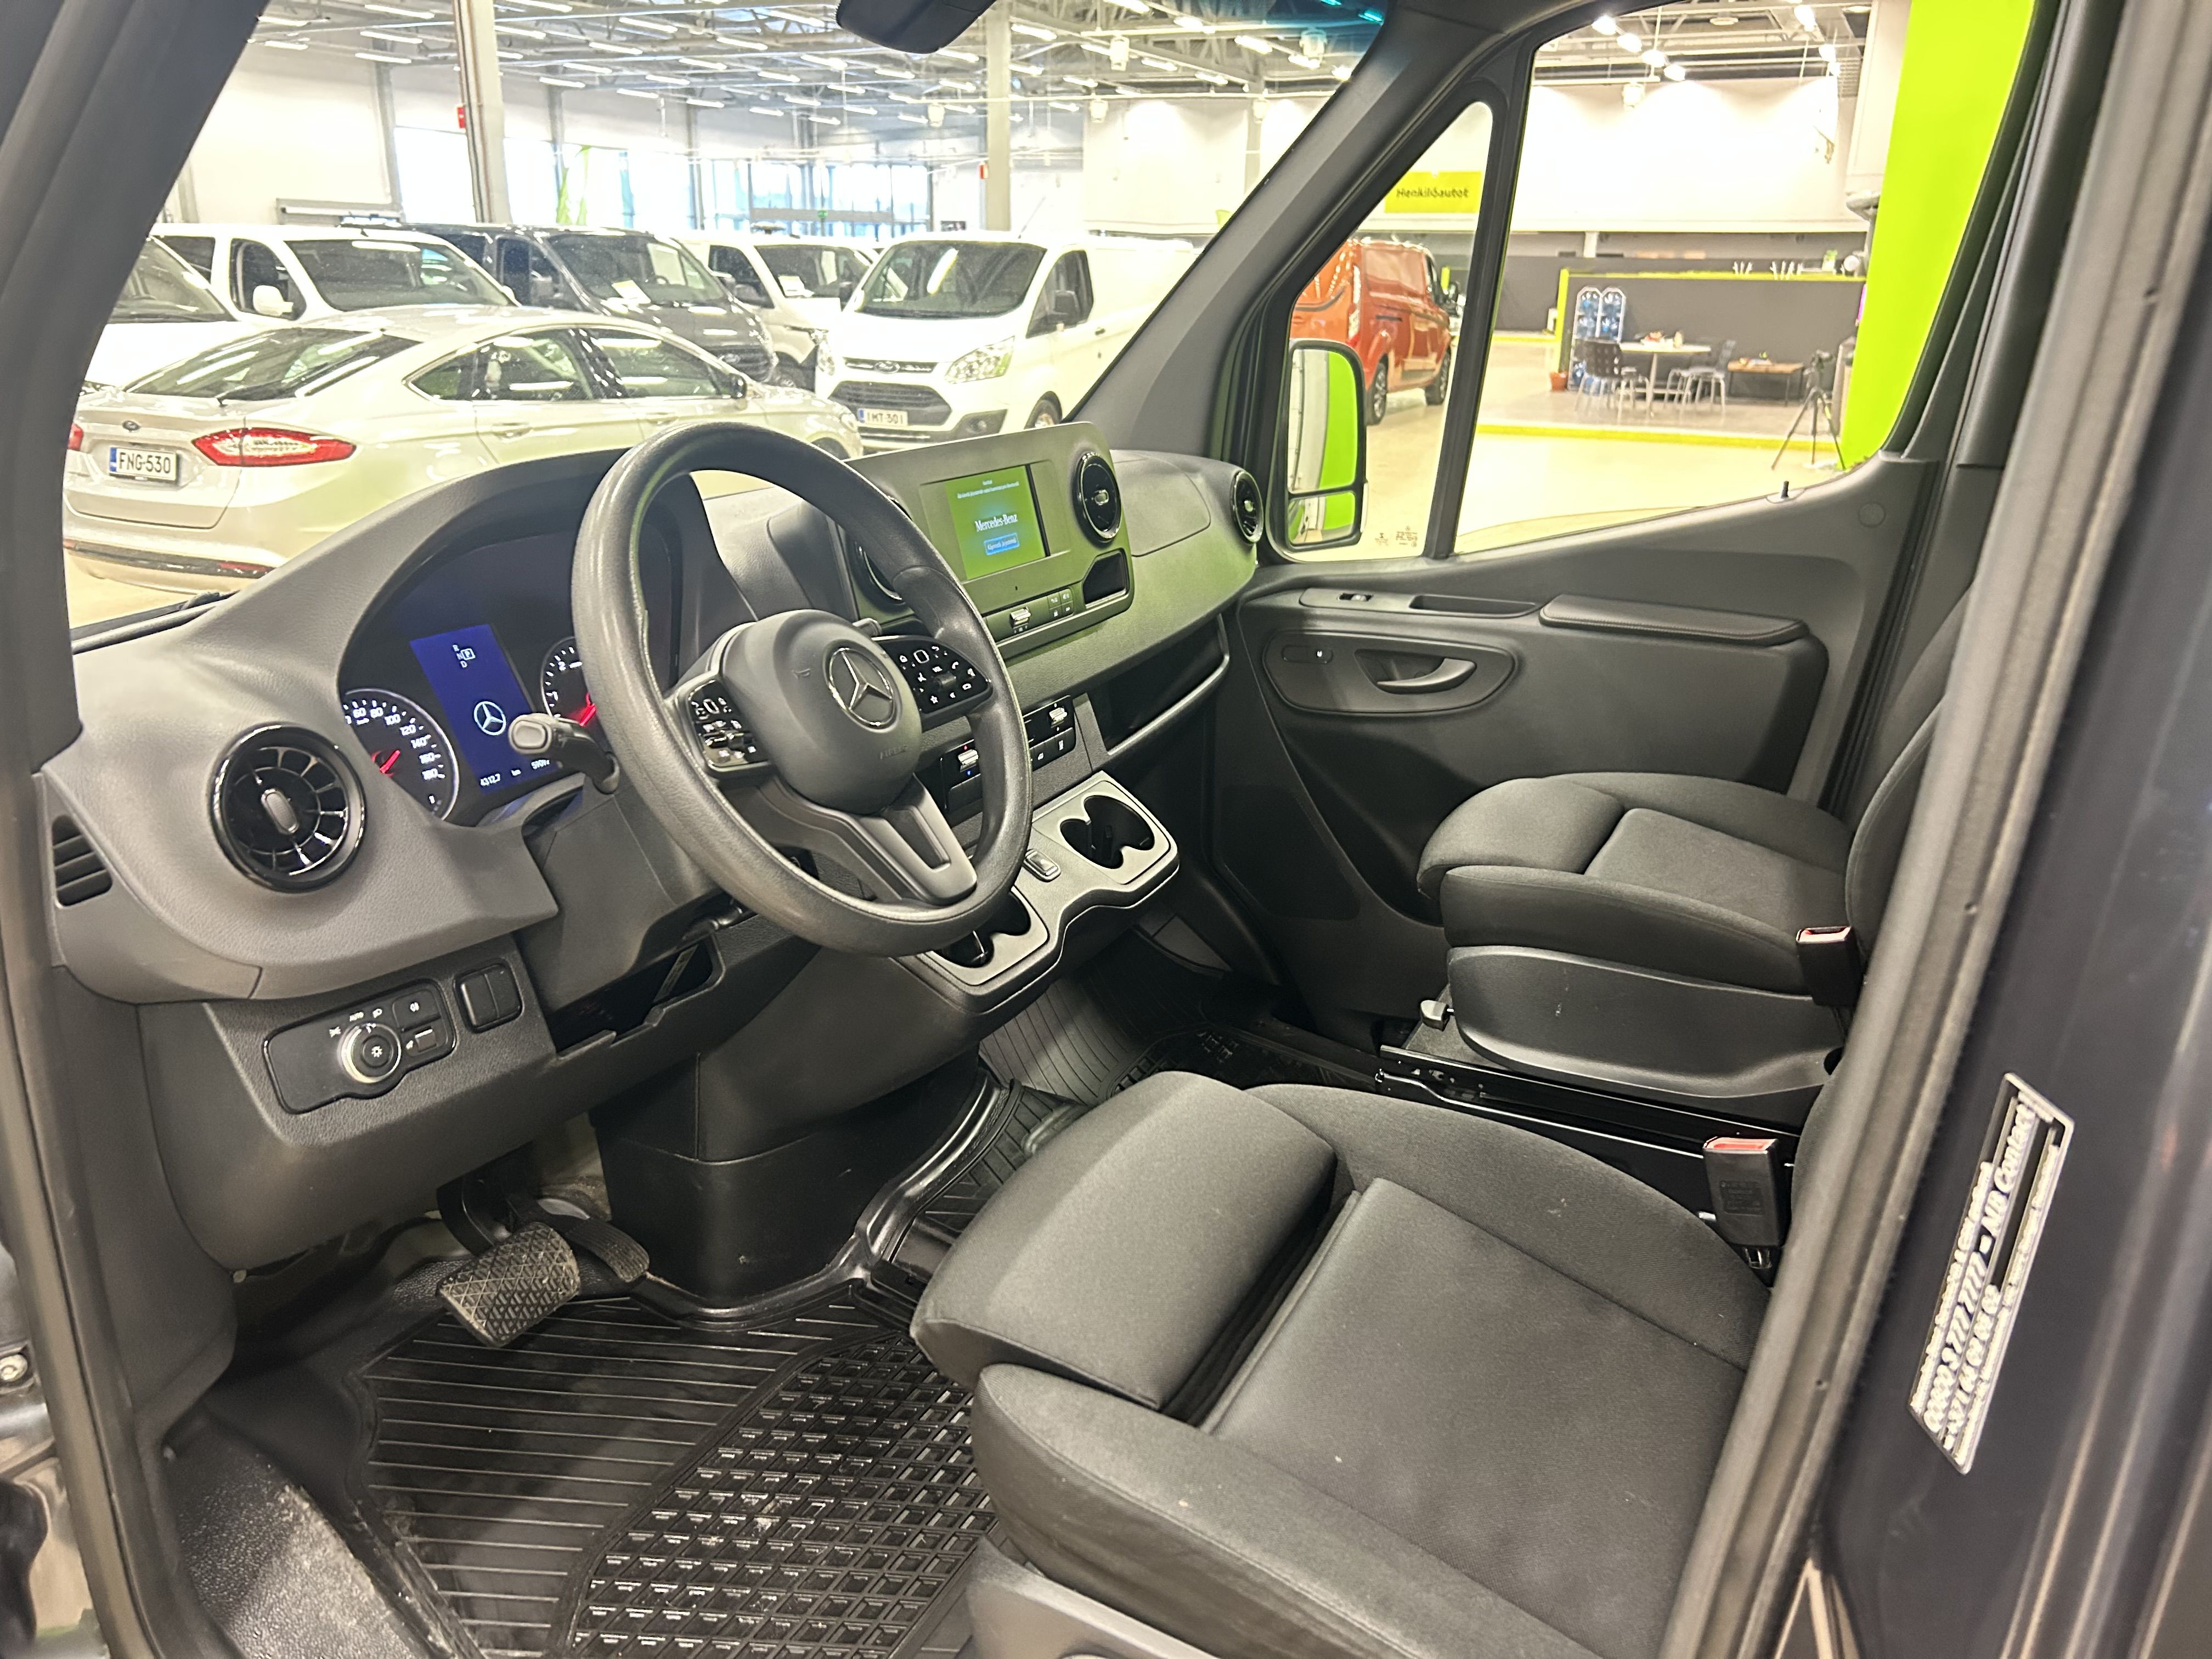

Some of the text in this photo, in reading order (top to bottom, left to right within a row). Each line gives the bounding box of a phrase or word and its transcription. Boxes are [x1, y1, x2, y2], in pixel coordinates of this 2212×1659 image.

[119, 452, 171, 473] FNG-530
[975, 514, 1018, 532] Mercedes-Benz
[558, 661, 566, 671] 2
[385, 714, 400, 726] 100
[399, 724, 416, 736] 120
[411, 738, 427, 749] 140
